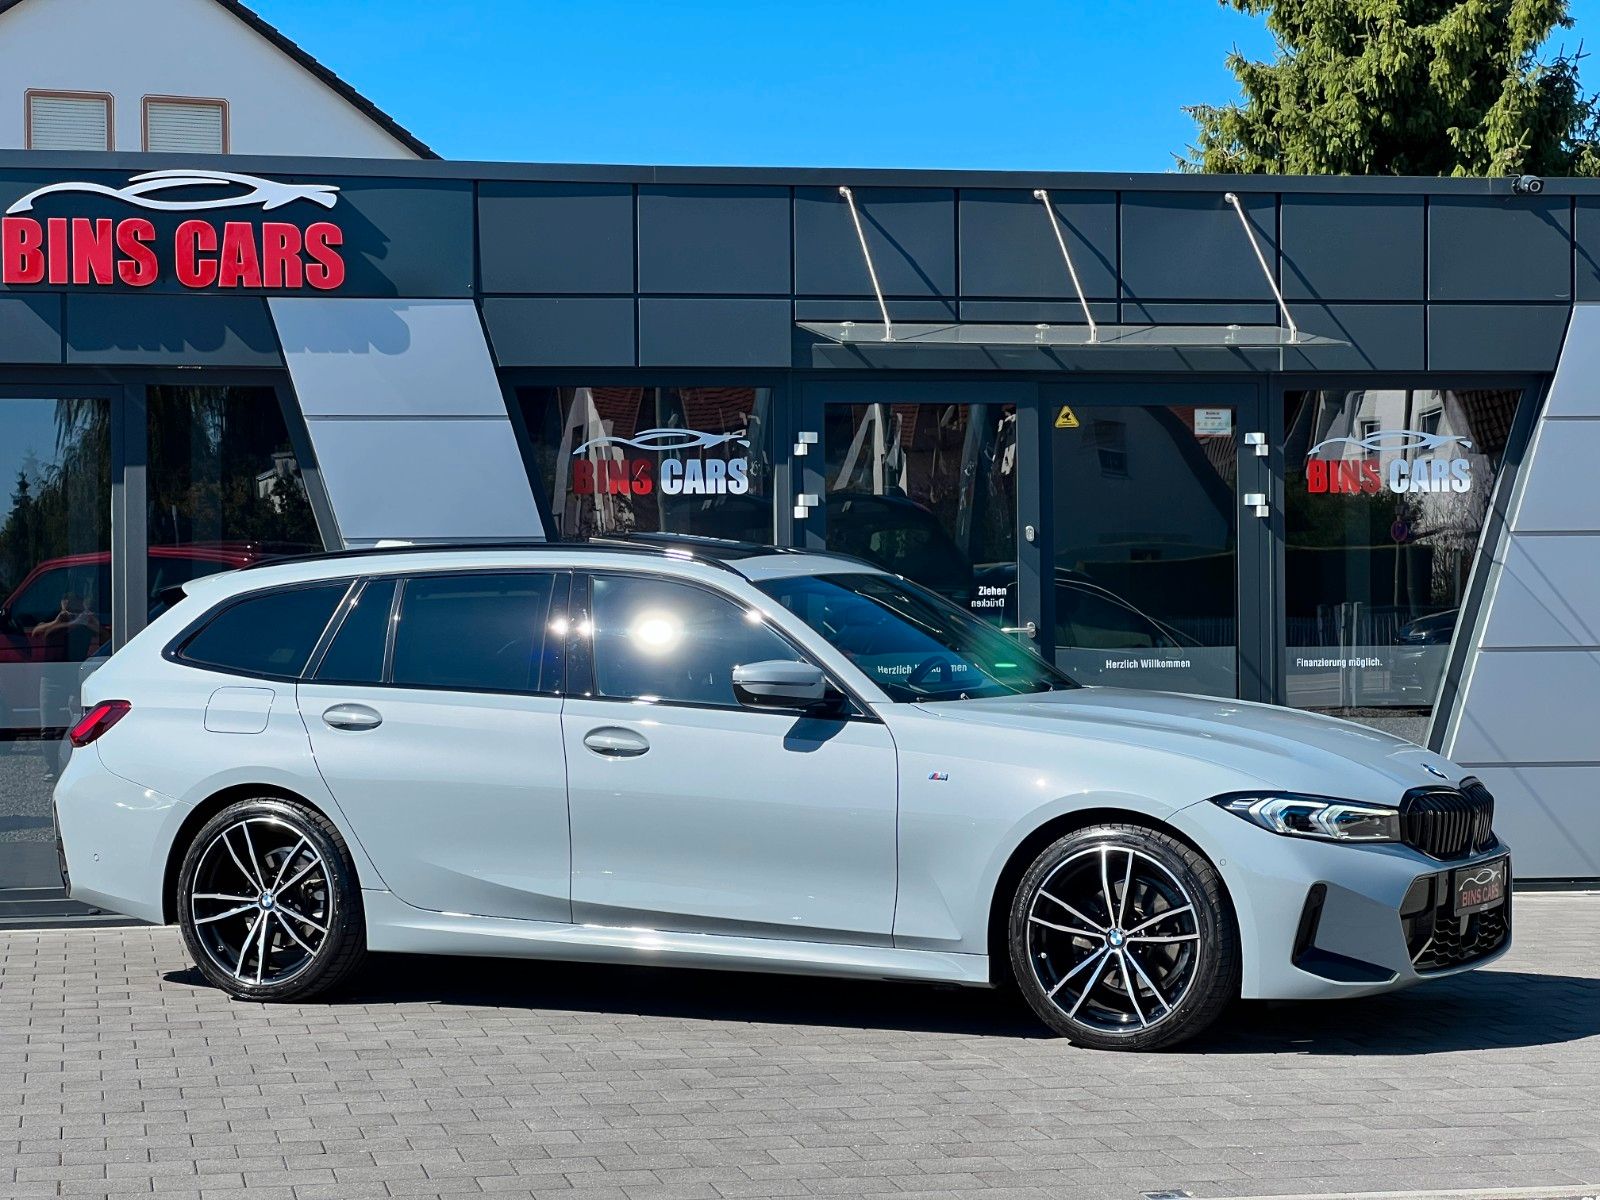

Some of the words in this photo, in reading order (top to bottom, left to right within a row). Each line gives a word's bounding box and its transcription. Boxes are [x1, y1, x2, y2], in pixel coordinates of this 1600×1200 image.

[2, 217, 158, 286] BINS
[175, 220, 345, 289] CARS
[573, 459, 653, 495] BINS
[660, 458, 749, 495] CARS
[1307, 459, 1381, 493] BINS
[1389, 459, 1471, 493] CARS
[978, 586, 1007, 596] Ziehen
[877, 665, 912, 675] Herzlich
[1105, 660, 1139, 669] Herzlich
[1140, 659, 1191, 669] Willkommen
[1296, 658, 1347, 669] Finanzierung
[1348, 657, 1383, 669] möglich.
[1463, 889, 1481, 906] BINS
